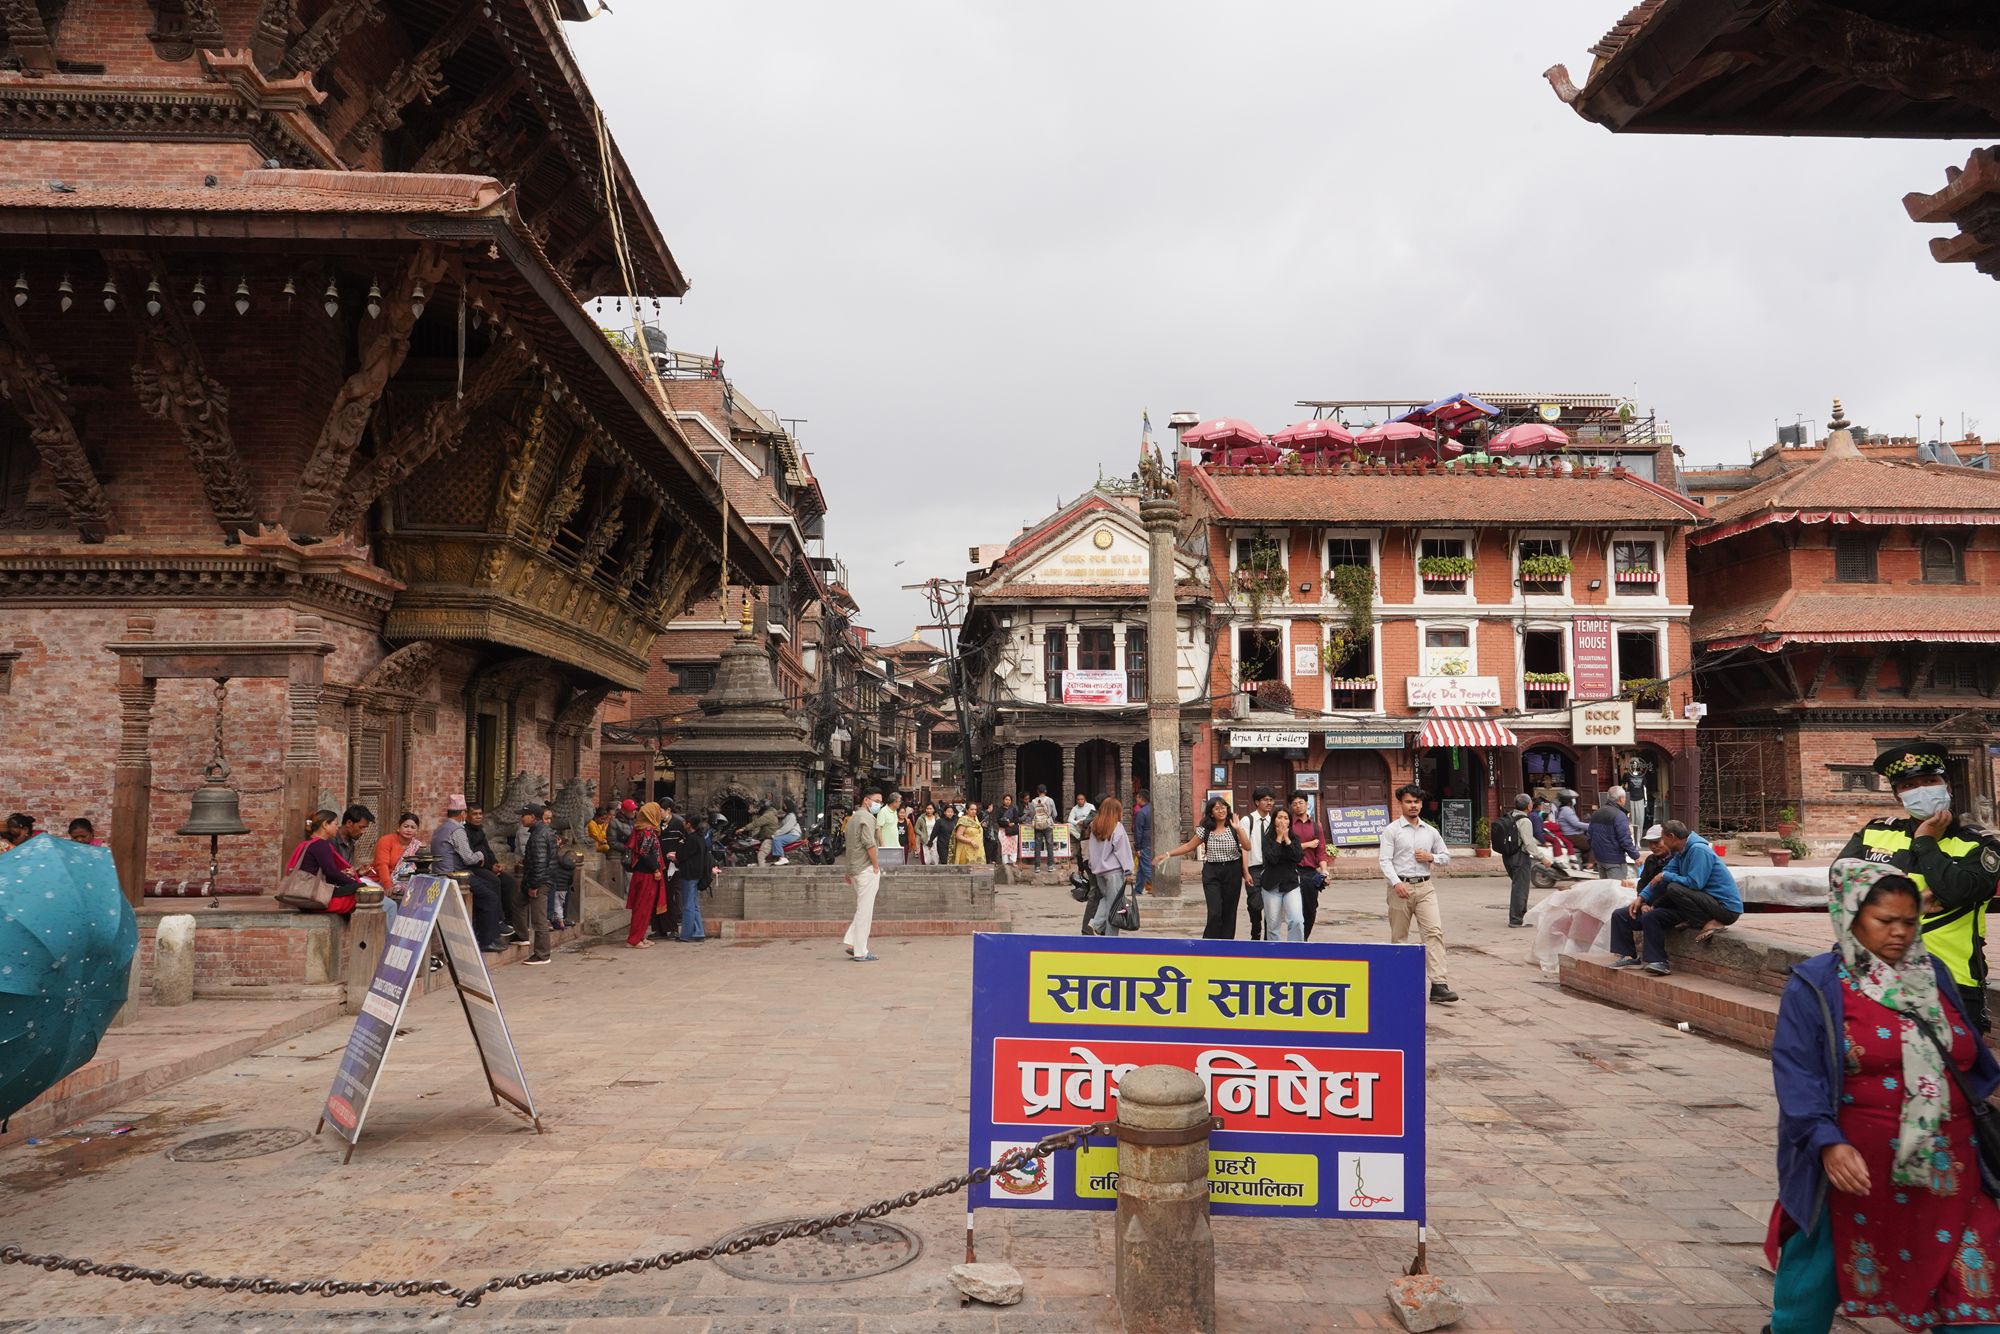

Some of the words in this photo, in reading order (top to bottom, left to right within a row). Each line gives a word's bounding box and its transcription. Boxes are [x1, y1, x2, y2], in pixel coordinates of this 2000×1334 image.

[1577, 620, 1608, 632] TEMPLE
[1579, 636, 1607, 649] HOUSE
[1412, 689, 1437, 702] Cafe
[1441, 688, 1457, 699] Du
[1459, 688, 1497, 700] Temple
[1585, 710, 1621, 721] ROCK
[1585, 724, 1621, 736] SHOP
[1231, 733, 1251, 743] Arjun
[1256, 733, 1271, 742] Art
[1276, 733, 1308, 745] Gallery
[1327, 735, 1342, 744] PATAN
[1865, 849, 1892, 863] LMC
[1047, 966, 1192, 1015] सवारी
[1208, 979, 1351, 1019] साधन
[1194, 1049, 1380, 1120] निषेध
[1214, 1156, 1257, 1175] प्रहरी
